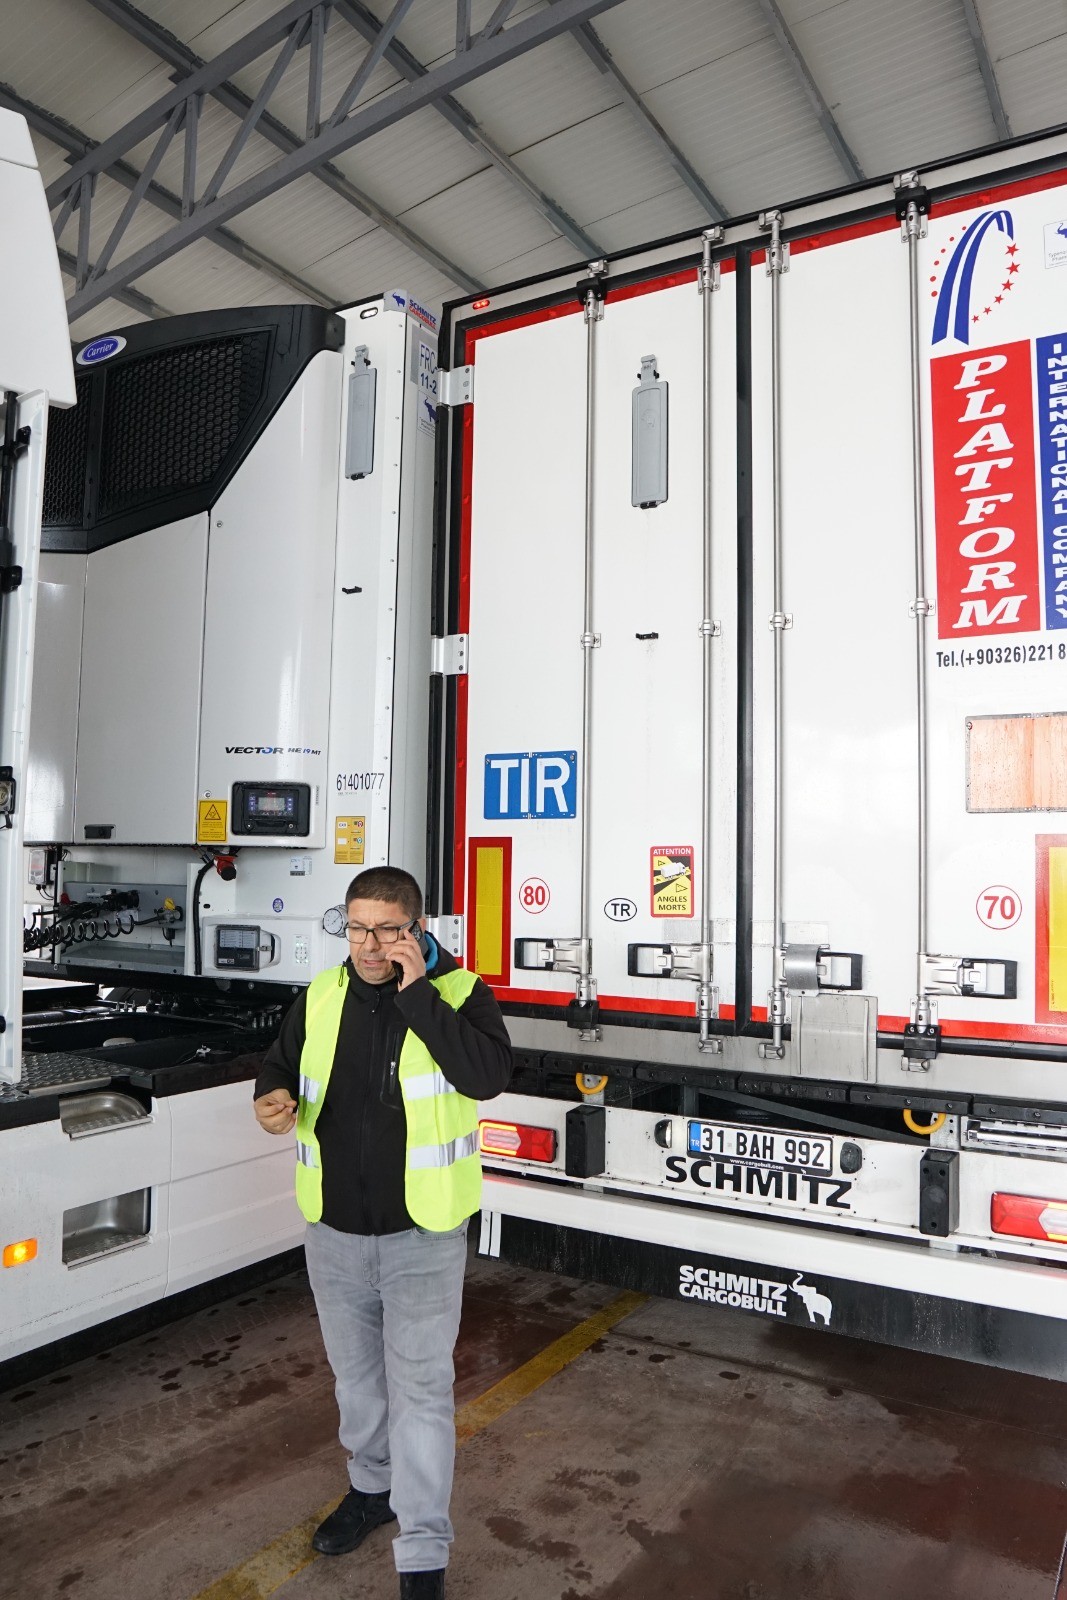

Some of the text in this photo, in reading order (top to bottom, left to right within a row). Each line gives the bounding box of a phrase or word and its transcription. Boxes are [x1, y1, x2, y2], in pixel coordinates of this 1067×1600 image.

[409, 299, 437, 325] SCHMITZ
[86, 343, 114, 358] Carrier
[952, 354, 1028, 629] PLATFORM
[225, 746, 284, 755] VECTOR
[336, 772, 385, 791] 61401077
[490, 757, 571, 814] TIR
[653, 847, 691, 855] ATTENTION
[523, 885, 546, 906] 80
[657, 895, 688, 903] ANGLES
[610, 902, 631, 917] TR
[983, 895, 1016, 920] 70
[691, 1138, 700, 1147] TR
[702, 1127, 824, 1167] 31 BAH 992
[729, 1157, 784, 1171] www.cargobull.com
[665, 1155, 852, 1209] SCHMITZ
[679, 1264, 788, 1302] SCHMITZ
[678, 1283, 787, 1317] CARGOBULL
